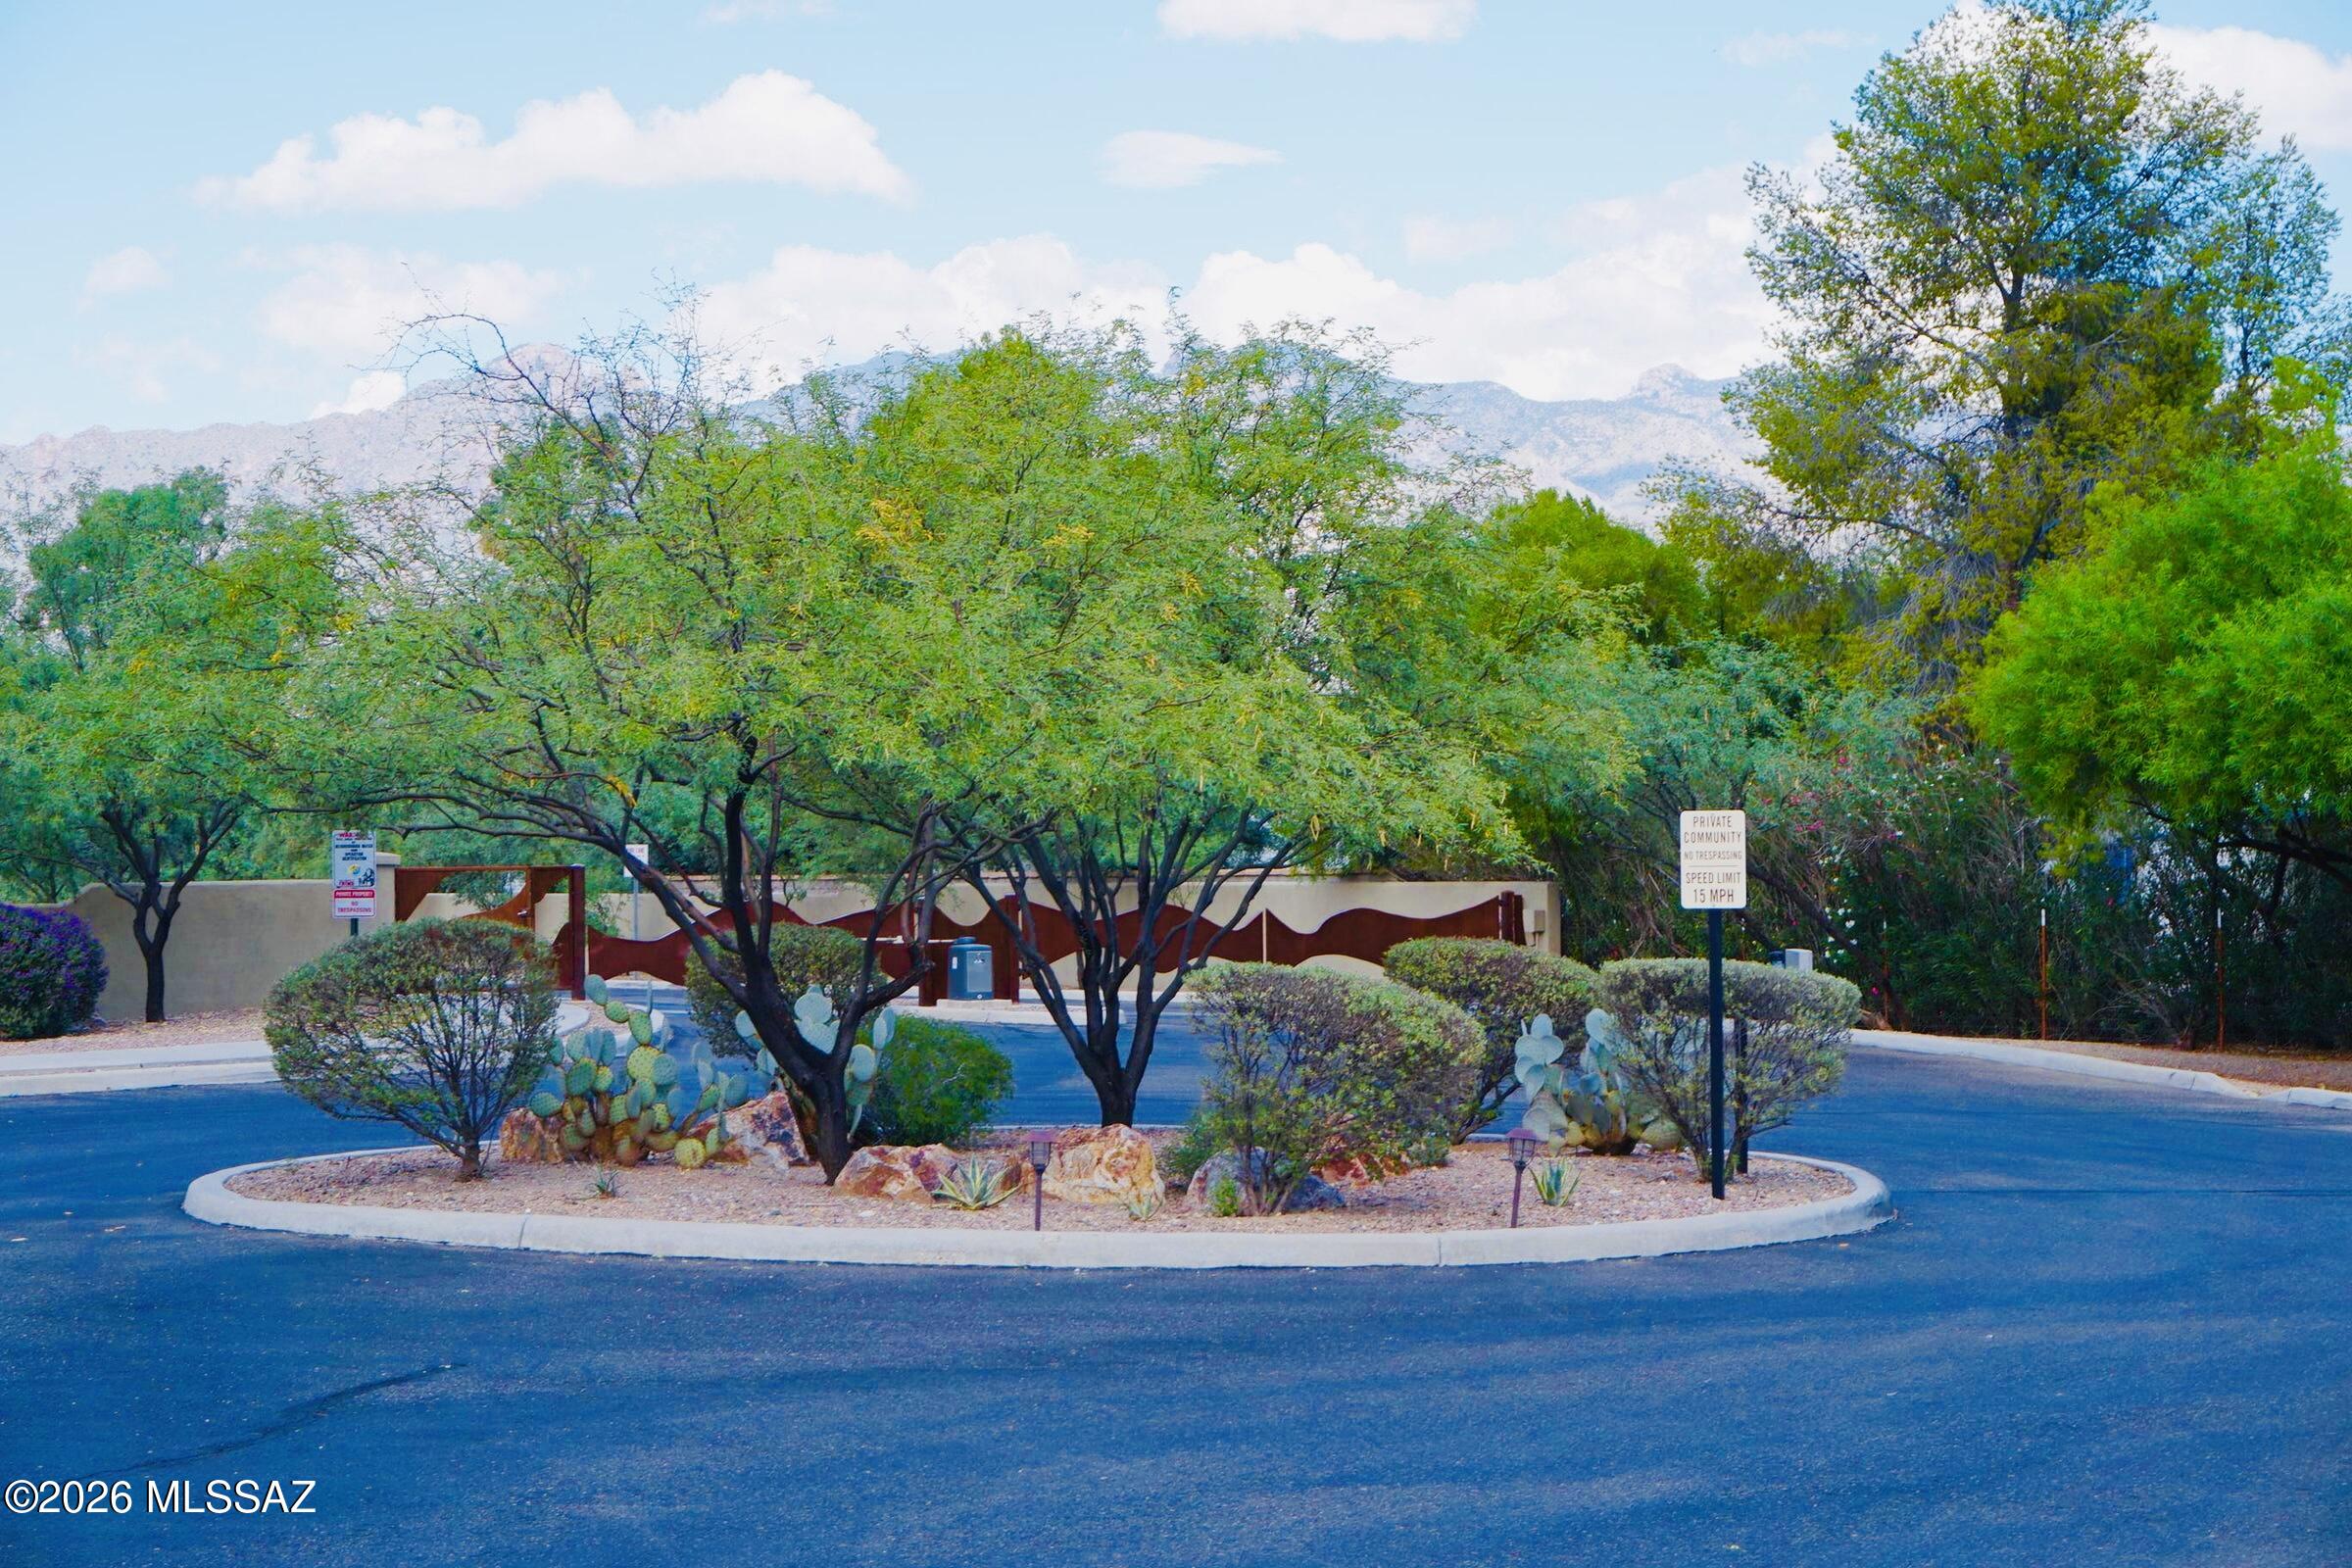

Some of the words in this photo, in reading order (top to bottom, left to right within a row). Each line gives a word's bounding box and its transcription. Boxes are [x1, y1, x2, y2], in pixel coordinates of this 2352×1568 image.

[1692, 815, 1733, 828] PRIVATE
[1684, 831, 1741, 844] COMMUNITY
[1684, 851, 1693, 860] NO
[1695, 851, 1742, 860] TRESPASSING
[1686, 872, 1714, 884] SPEED
[1717, 872, 1741, 884] LIMIT
[1693, 889, 1706, 904] 15
[1710, 889, 1735, 903] MPH
